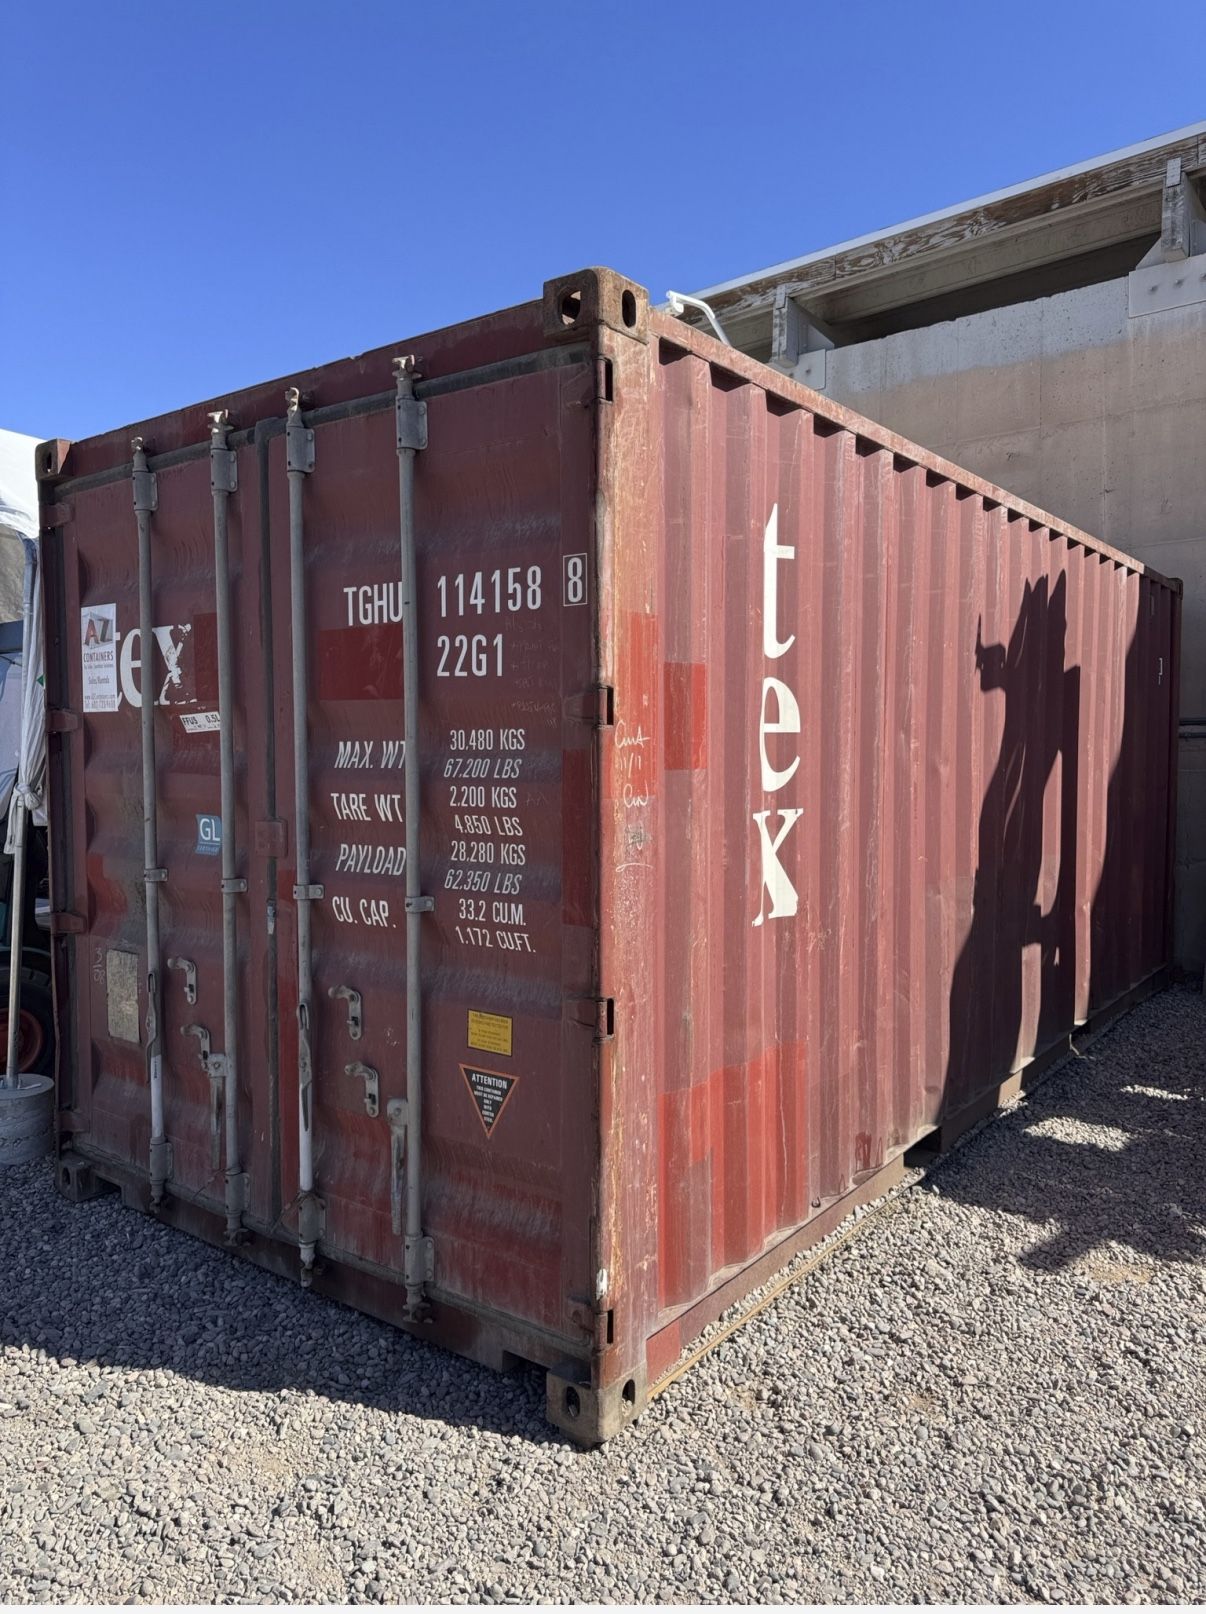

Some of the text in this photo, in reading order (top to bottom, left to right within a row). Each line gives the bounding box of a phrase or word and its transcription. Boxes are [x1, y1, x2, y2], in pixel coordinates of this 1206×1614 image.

[343, 557, 583, 626] TGHU 114158 8
[83, 651, 114, 662] CONTAINERS
[436, 633, 503, 676] 22G1
[752, 503, 803, 927] tex
[500, 729, 525, 750] KGS
[334, 741, 373, 769] MAX.
[494, 758, 522, 778] LBS
[330, 793, 403, 823] TARE WT
[492, 787, 517, 808] KGS
[200, 818, 221, 841] GL
[494, 816, 523, 836] LBS
[335, 844, 407, 876] PAYLOAD
[501, 843, 526, 866] KGS
[494, 872, 522, 895] LBS
[332, 896, 396, 928] CU. CAP.
[459, 898, 527, 926] 33.2 CU.M.
[471, 1073, 508, 1089] ATTENTION
